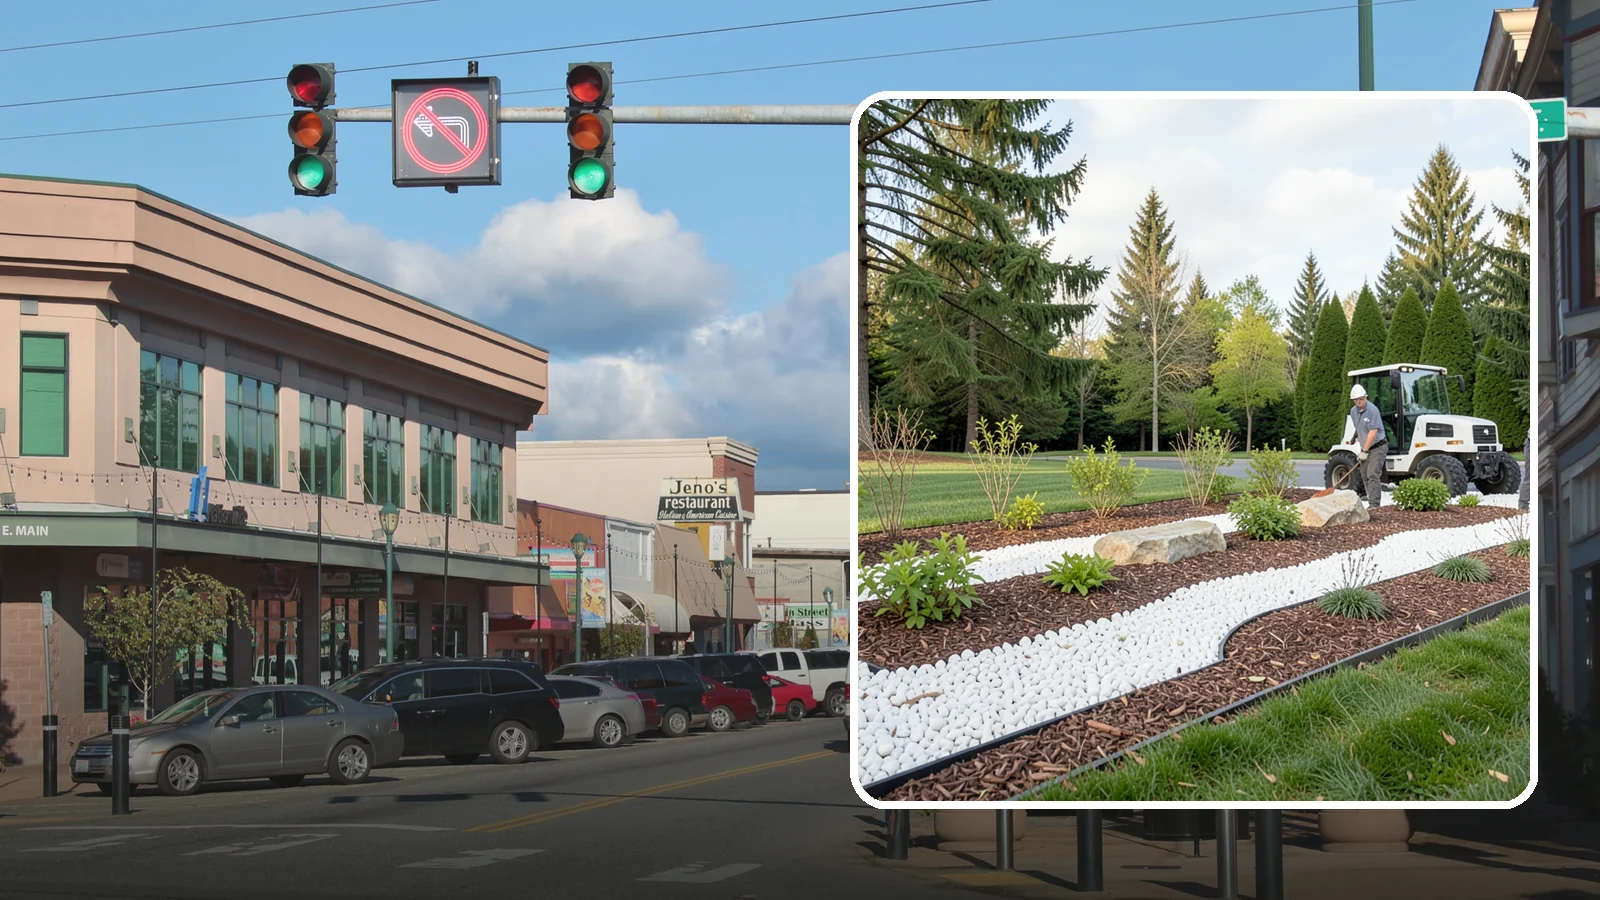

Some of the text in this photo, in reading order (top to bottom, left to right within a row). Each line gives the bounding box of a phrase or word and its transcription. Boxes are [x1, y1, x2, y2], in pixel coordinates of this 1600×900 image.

[670, 480, 727, 494] Jeno's
[665, 496, 731, 509] restaurant
[658, 509, 682, 520] Italian
[686, 509, 714, 519] American
[715, 509, 738, 519] Cuisine
[2, 525, 49, 536] E. MAIN
[797, 607, 828, 617] Street
